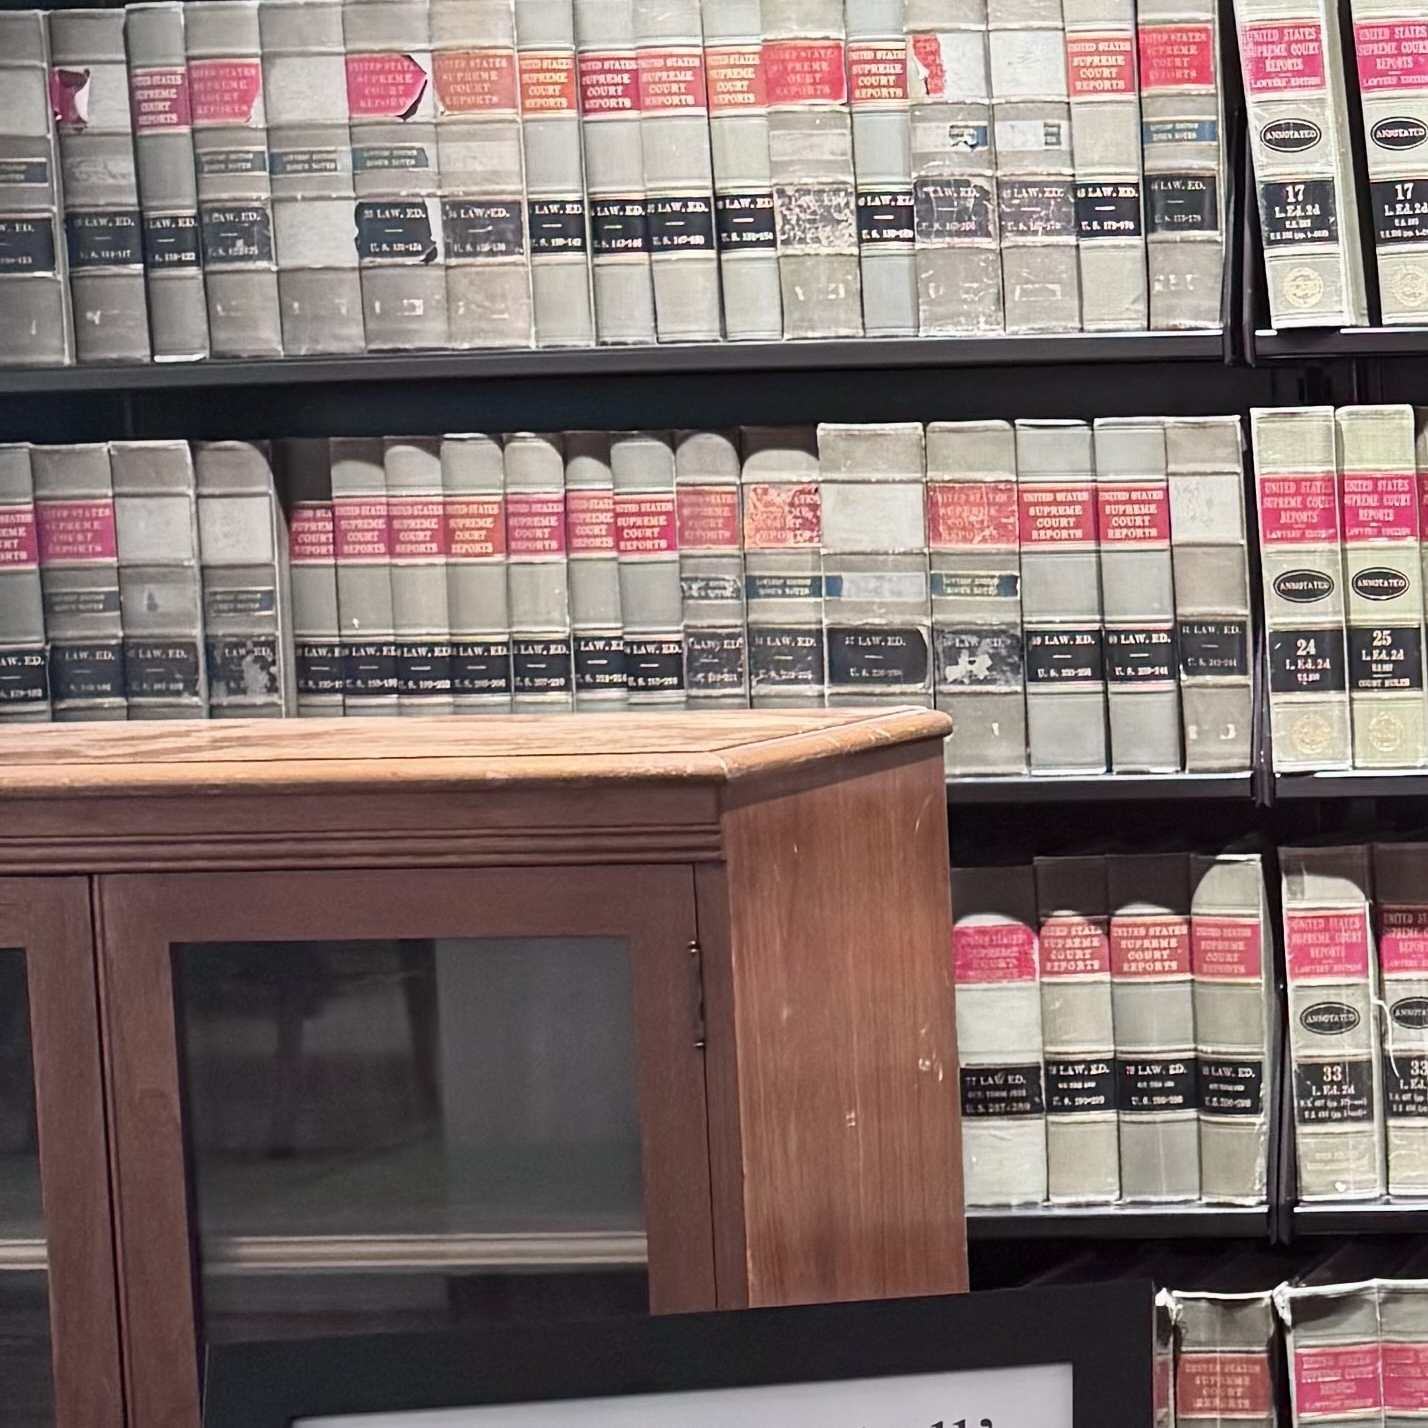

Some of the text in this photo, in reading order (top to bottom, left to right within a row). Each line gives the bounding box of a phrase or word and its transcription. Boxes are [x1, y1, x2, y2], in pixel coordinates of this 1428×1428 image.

[1285, 184, 1305, 203] 17
[1029, 505, 1083, 516] SUPREME
[1036, 517, 1076, 528] COURT
[1031, 529, 1083, 540] REPORTS
